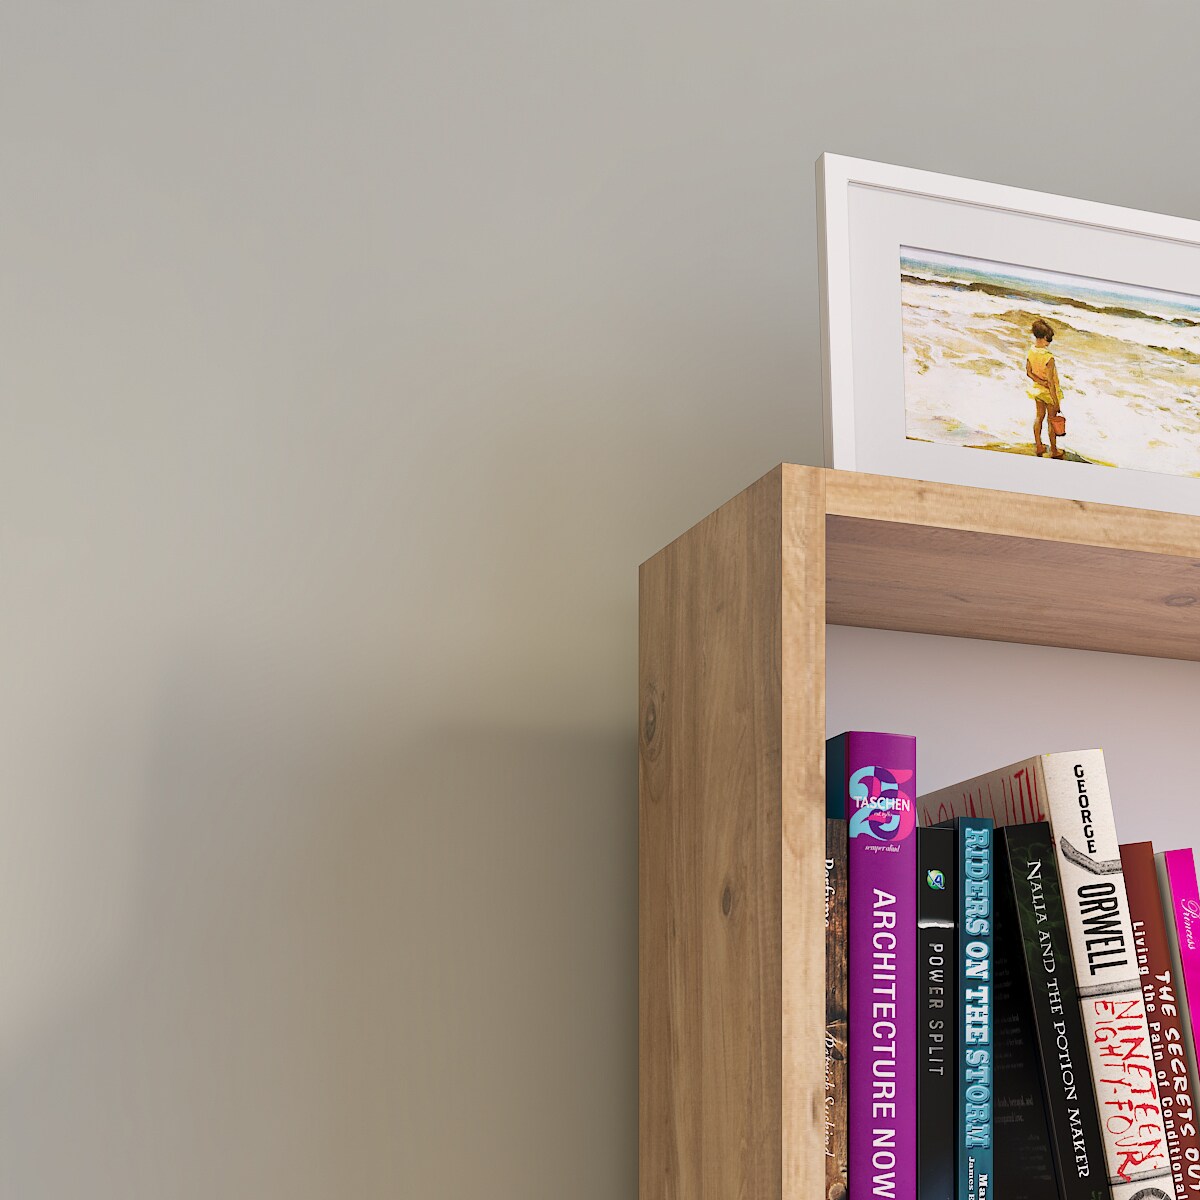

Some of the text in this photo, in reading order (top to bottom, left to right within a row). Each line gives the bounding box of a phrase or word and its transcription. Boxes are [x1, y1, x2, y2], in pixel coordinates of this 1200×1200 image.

[854, 796, 911, 812] TASCHEN
[1074, 764, 1097, 854] GEORGE
[872, 888, 896, 1118] ARCHITECTURE
[965, 828, 992, 1149] RIDERS ON THE STORM
[1077, 882, 1128, 976] ORWELL
[1155, 970, 1177, 1018] THE
[928, 943, 944, 1076] POWER SPLIT
[1026, 858, 1090, 1178] NALIA AND THE POTION MAKER
[1132, 920, 1150, 976] Living
[1144, 984, 1156, 1013] the
[1150, 1022, 1164, 1061] Pain
[1158, 1070, 1168, 1088] of
[1094, 1000, 1149, 1183] EIGHTY-FOUR
[1115, 1000, 1164, 1163] NINETEEN
[1164, 1026, 1196, 1138] SECRETS
